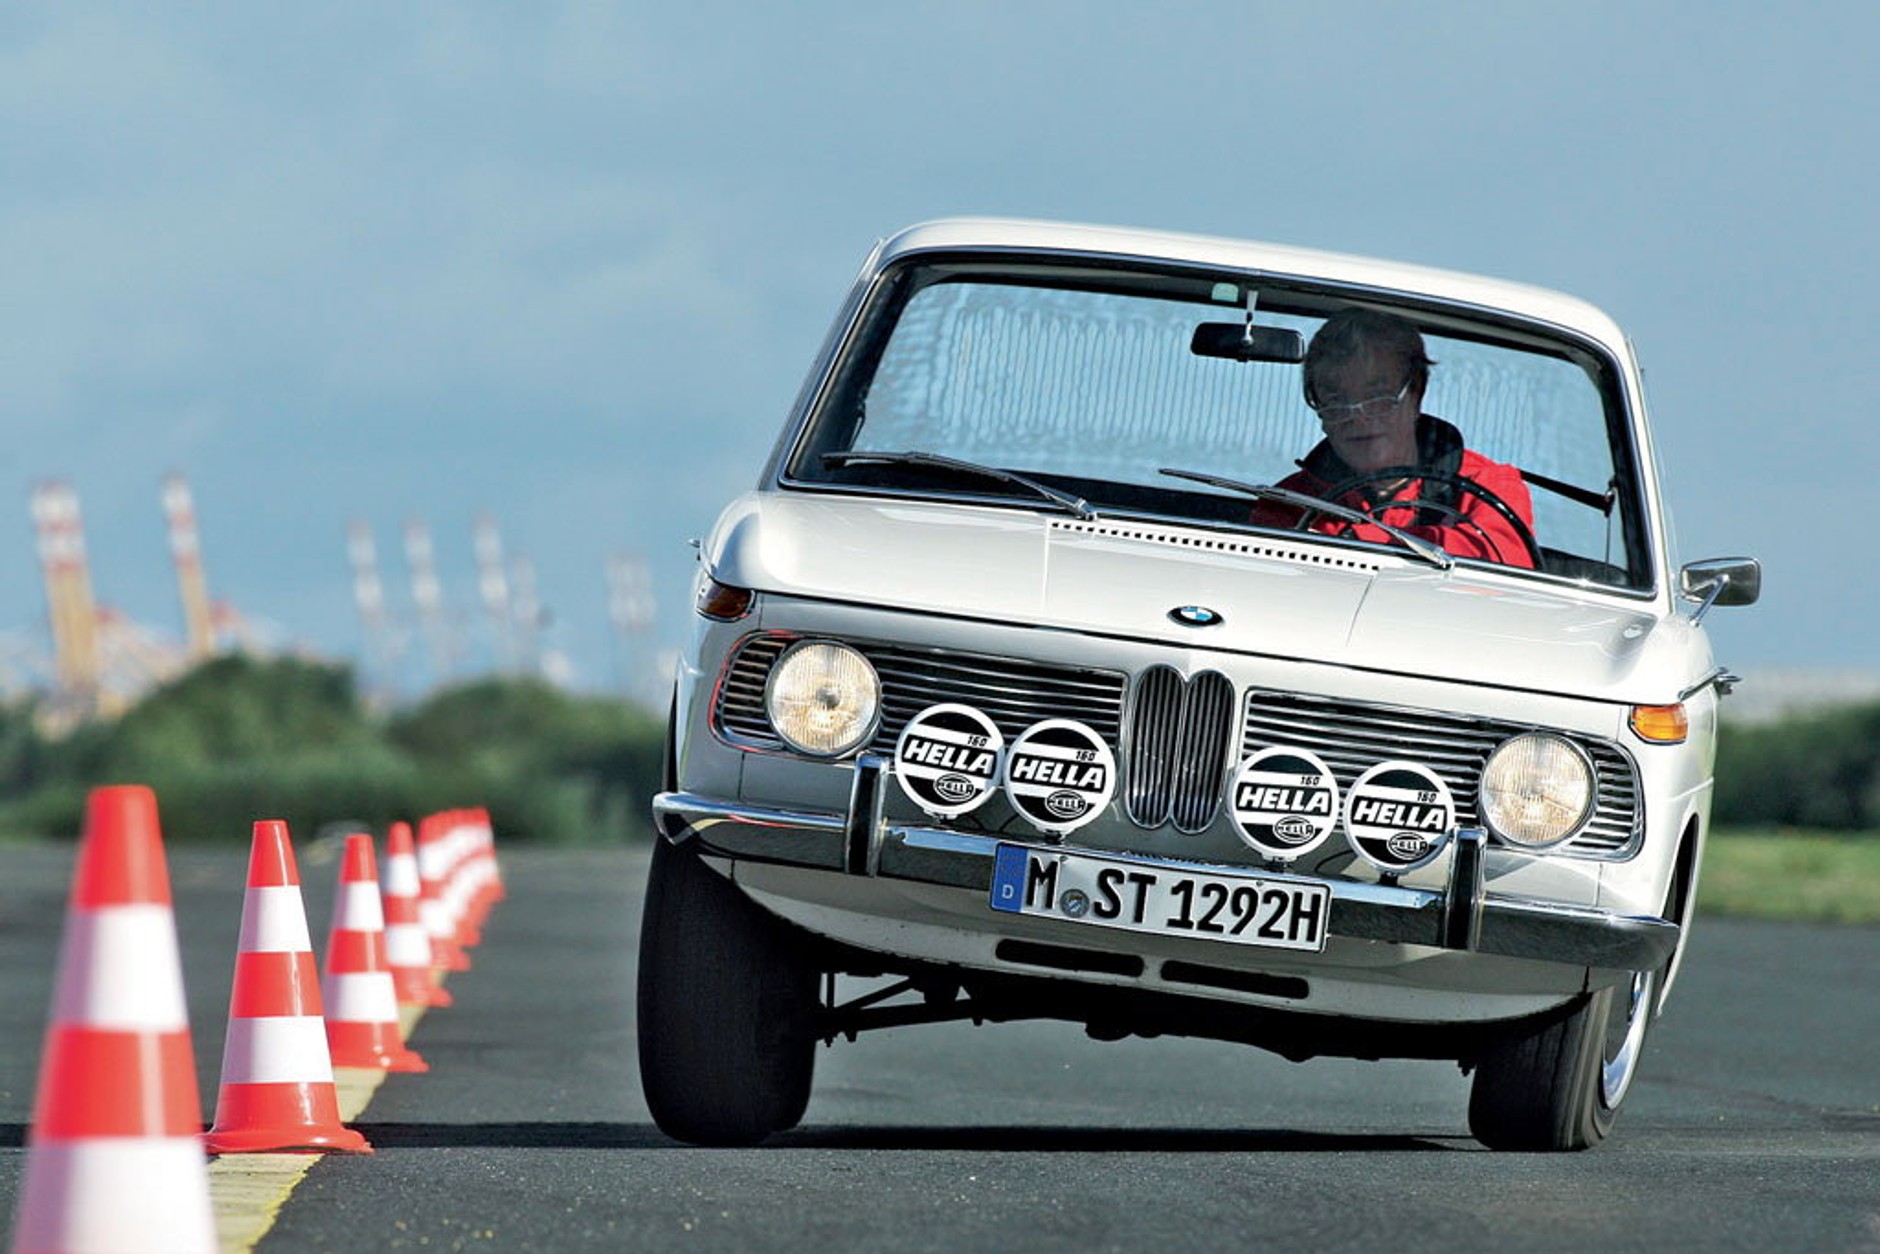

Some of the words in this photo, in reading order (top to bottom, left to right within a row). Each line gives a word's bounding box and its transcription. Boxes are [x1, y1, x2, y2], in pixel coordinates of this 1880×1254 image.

[904, 738, 995, 775] HELLA
[1012, 757, 1105, 789] HELLA
[1238, 785, 1330, 813] HELLA
[1353, 800, 1445, 830] HELLA
[1002, 885, 1013, 899] D
[1026, 857, 1058, 909] M
[1094, 868, 1158, 924] ST
[1166, 879, 1322, 943] 1292H
